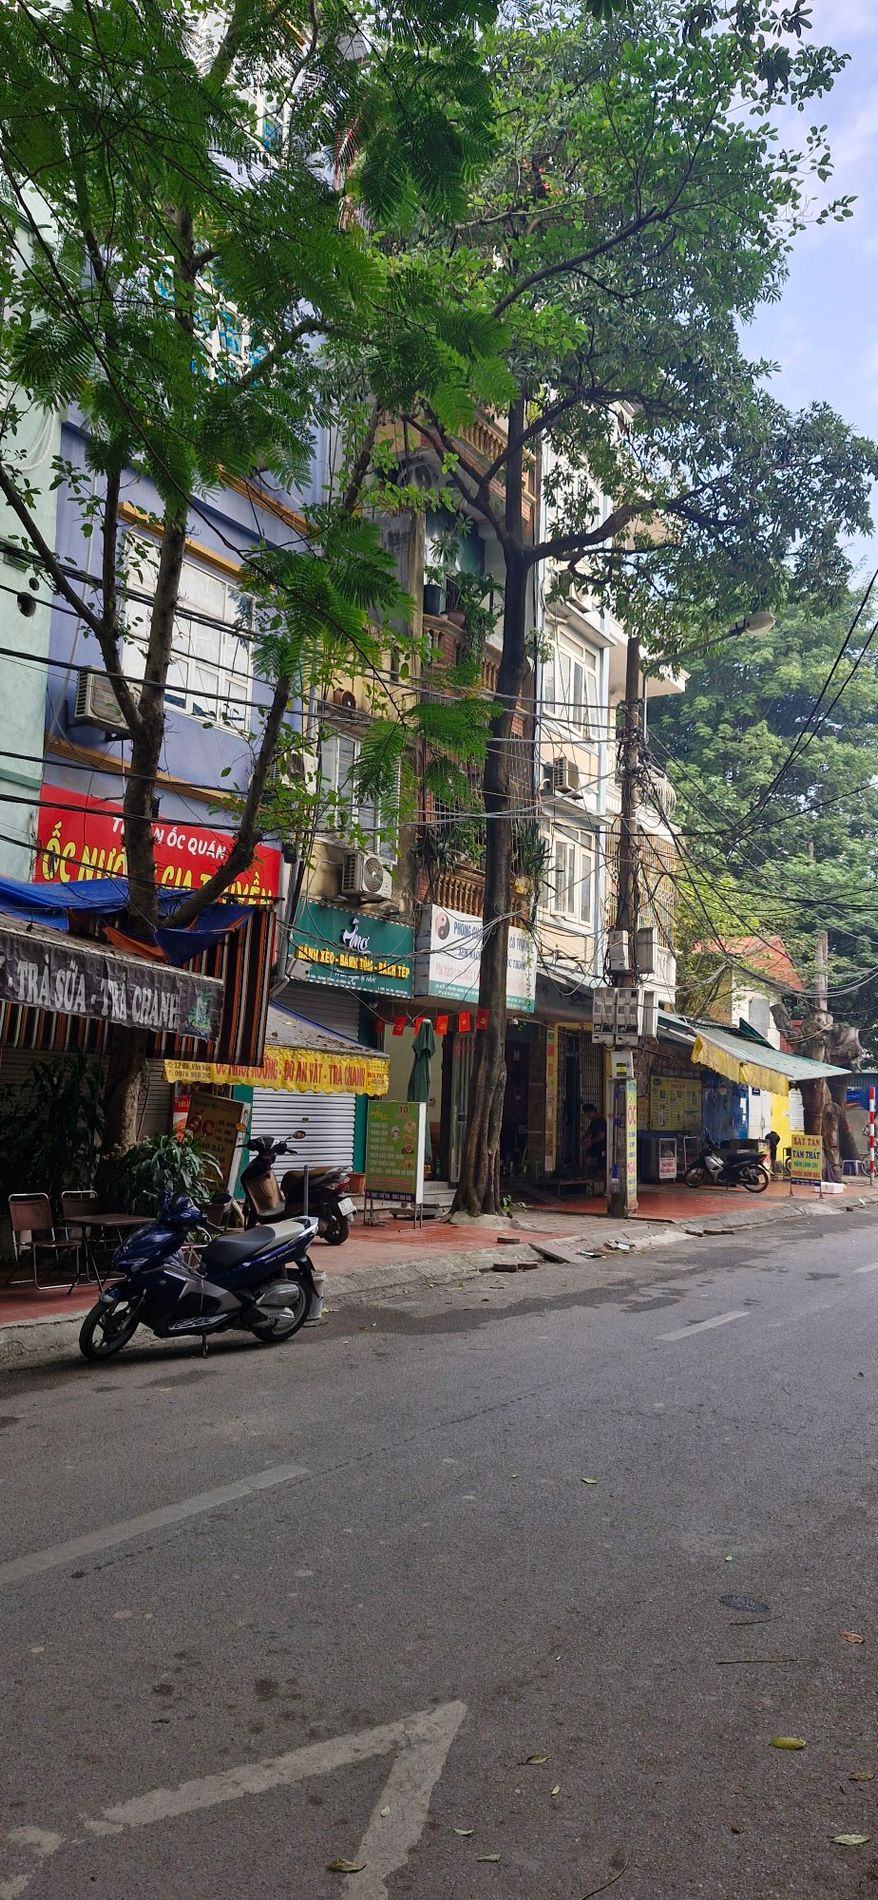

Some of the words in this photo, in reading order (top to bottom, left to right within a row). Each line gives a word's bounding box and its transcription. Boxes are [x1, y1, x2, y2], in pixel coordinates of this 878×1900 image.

[42, 820, 76, 883] ỐC
[166, 826, 186, 849] ỐC
[187, 837, 227, 860] QUÁN
[17, 953, 50, 1006] TRÀ
[54, 959, 87, 1013] SỮA
[132, 985, 181, 1029] CHANH
